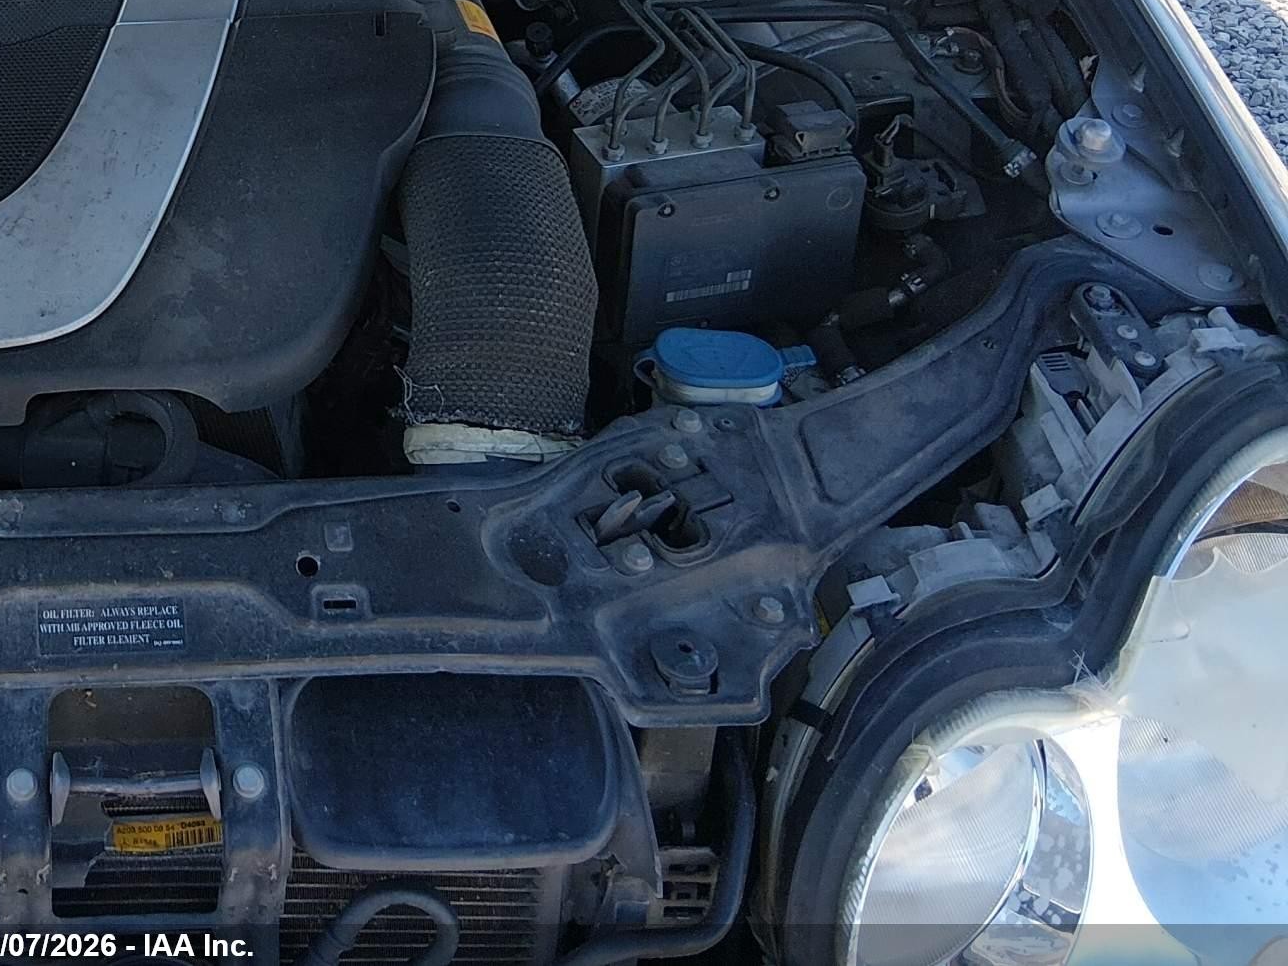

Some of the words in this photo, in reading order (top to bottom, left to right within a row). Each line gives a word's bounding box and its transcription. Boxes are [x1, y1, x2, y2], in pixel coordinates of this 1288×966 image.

[42, 609, 59, 619] OIL
[61, 608, 95, 619] FILTER:
[100, 607, 136, 618] ALWAYS
[137, 605, 178, 617] REPLACE
[40, 623, 64, 634] WITH
[65, 622, 81, 633] MB
[81, 621, 129, 632] APPROVED
[130, 619, 165, 631] FLEECE
[166, 619, 183, 629] OIL
[73, 635, 106, 646] FILTER
[107, 634, 150, 645] ELEMENT
